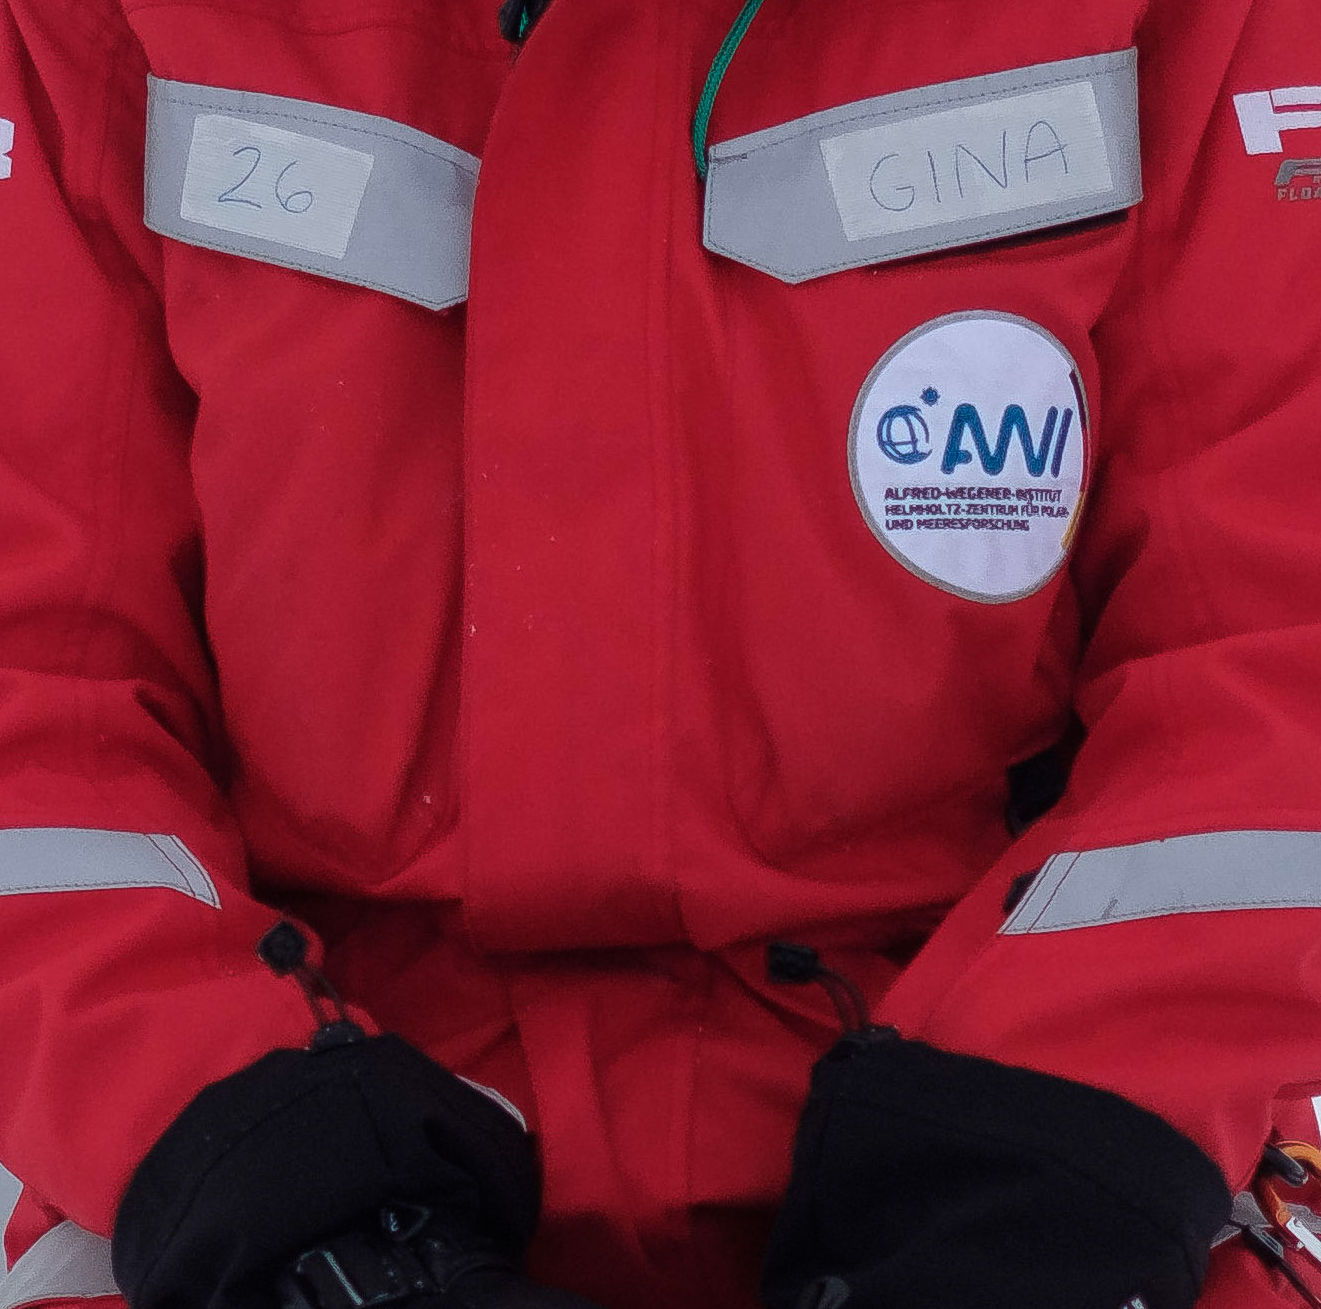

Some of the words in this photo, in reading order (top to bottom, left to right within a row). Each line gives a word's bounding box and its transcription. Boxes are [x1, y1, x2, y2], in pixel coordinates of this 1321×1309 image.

[218, 146, 314, 214] 26
[869, 120, 1068, 212] GINA
[940, 403, 1074, 478] AWI
